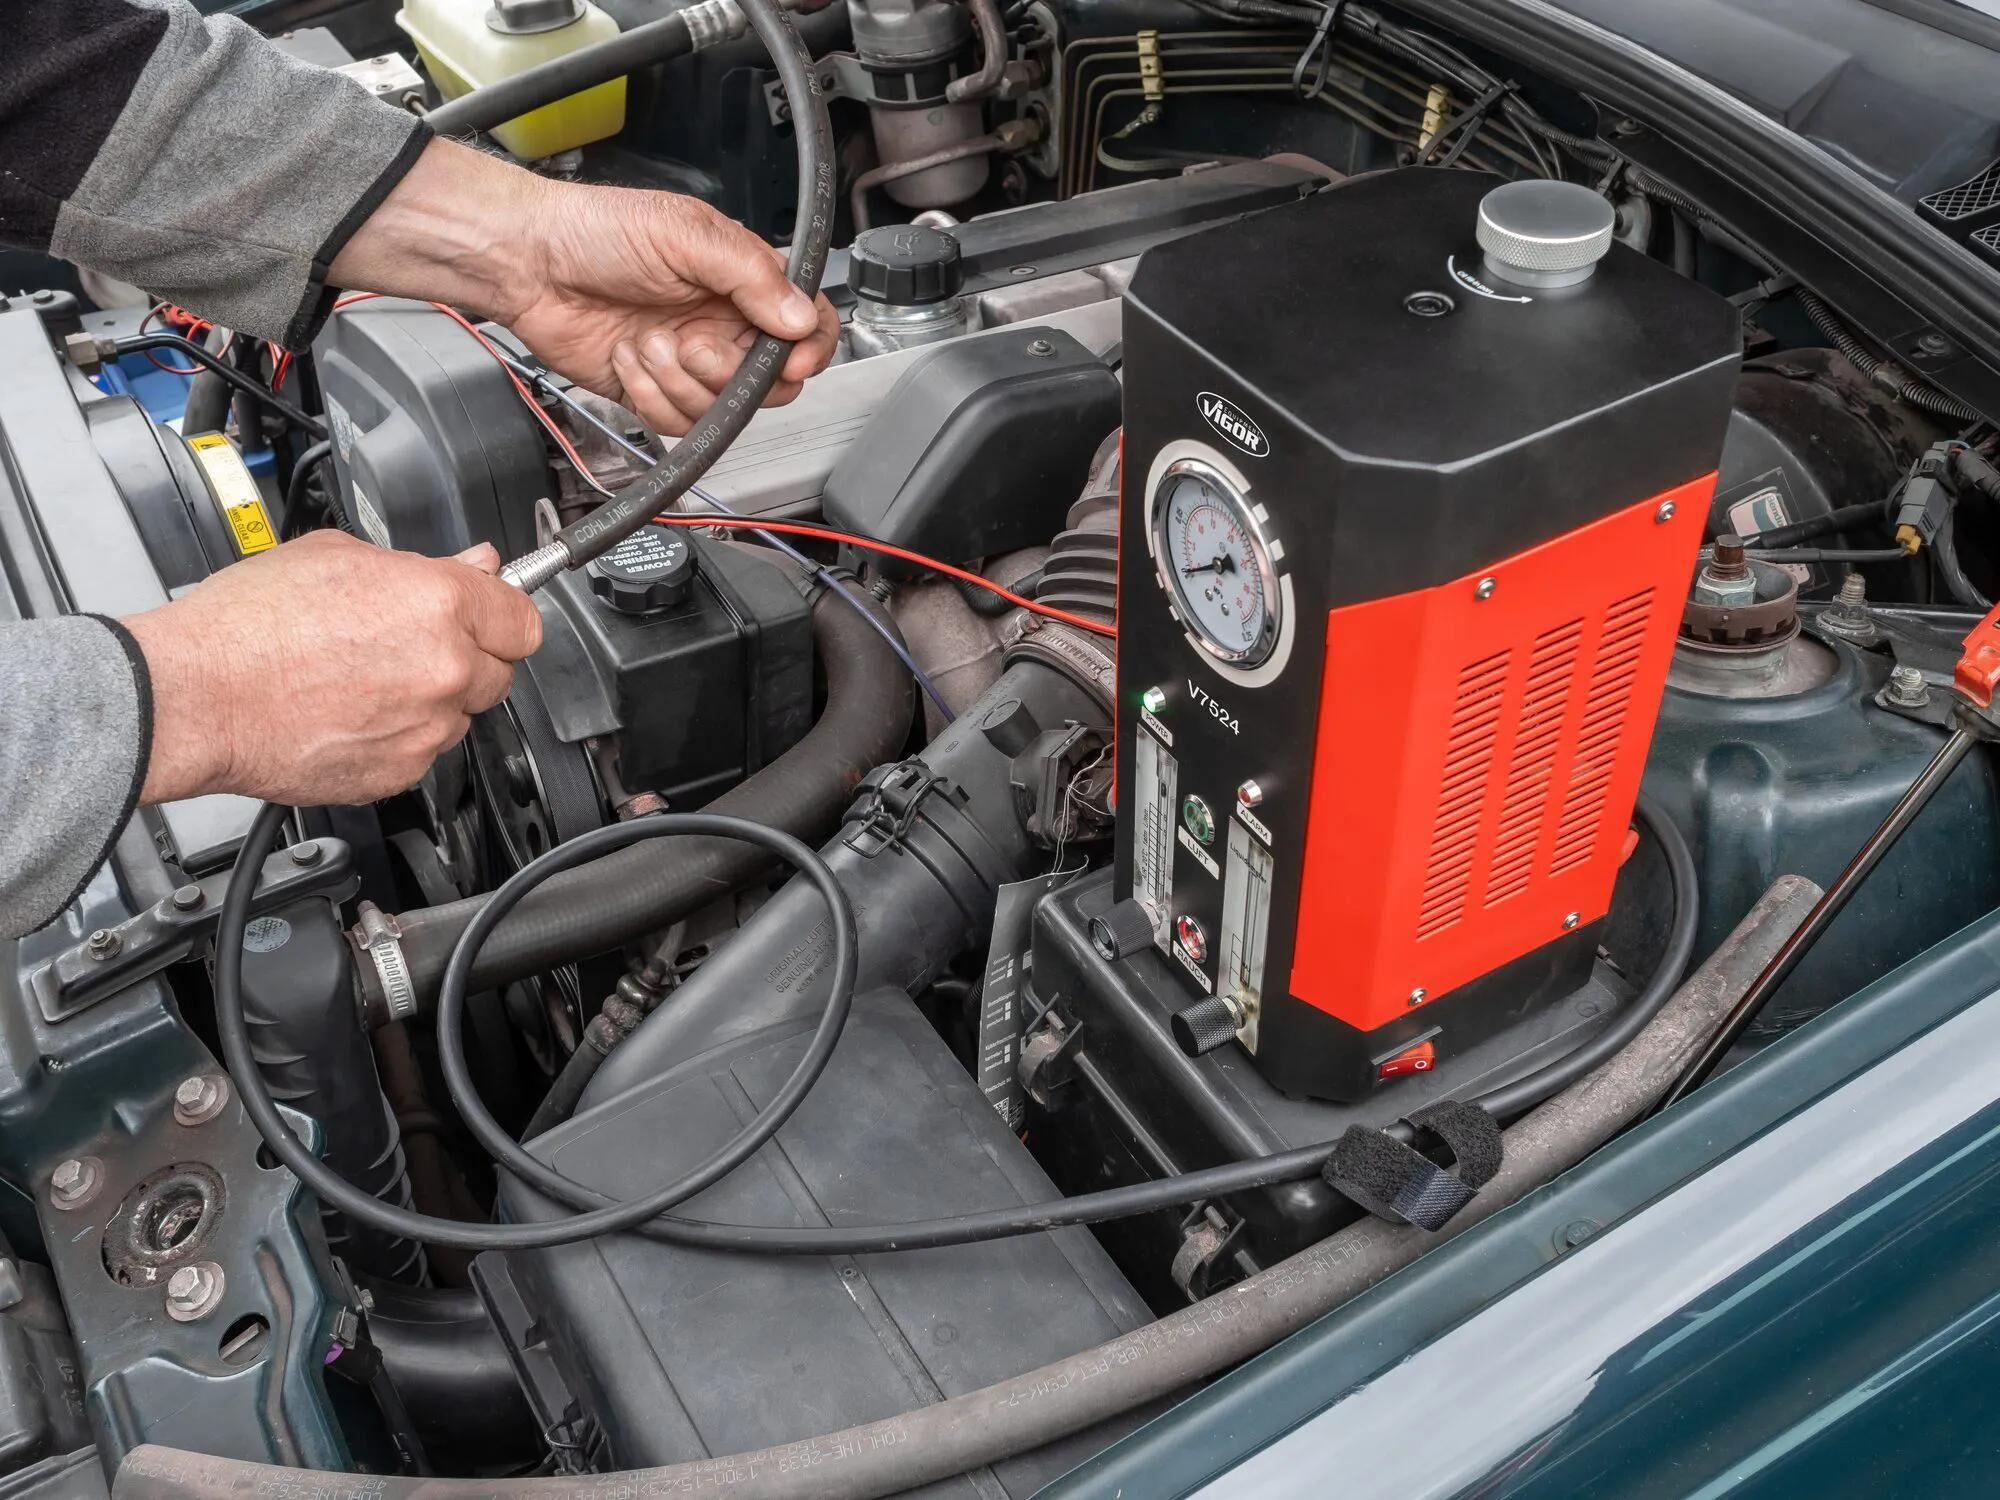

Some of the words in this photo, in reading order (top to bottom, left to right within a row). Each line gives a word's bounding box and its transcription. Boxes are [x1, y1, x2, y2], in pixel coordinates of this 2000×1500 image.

[813, 215, 826, 232] 32
[574, 501, 633, 544] COHLINE
[600, 551, 642, 561] OVERFILL
[617, 545, 638, 553] ONLY
[643, 540, 661, 548] USE
[614, 550, 675, 566] STEERING
[626, 560, 672, 573] POWER
[1188, 679, 1239, 735] V7524
[1145, 713, 1168, 738] POWER
[1241, 810, 1268, 839] ALARM
[1187, 839, 1208, 865] LUFT
[767, 944, 807, 984] ORIGINAL
[776, 953, 815, 993] GENUINE
[1177, 949, 1207, 985] RAUCH
